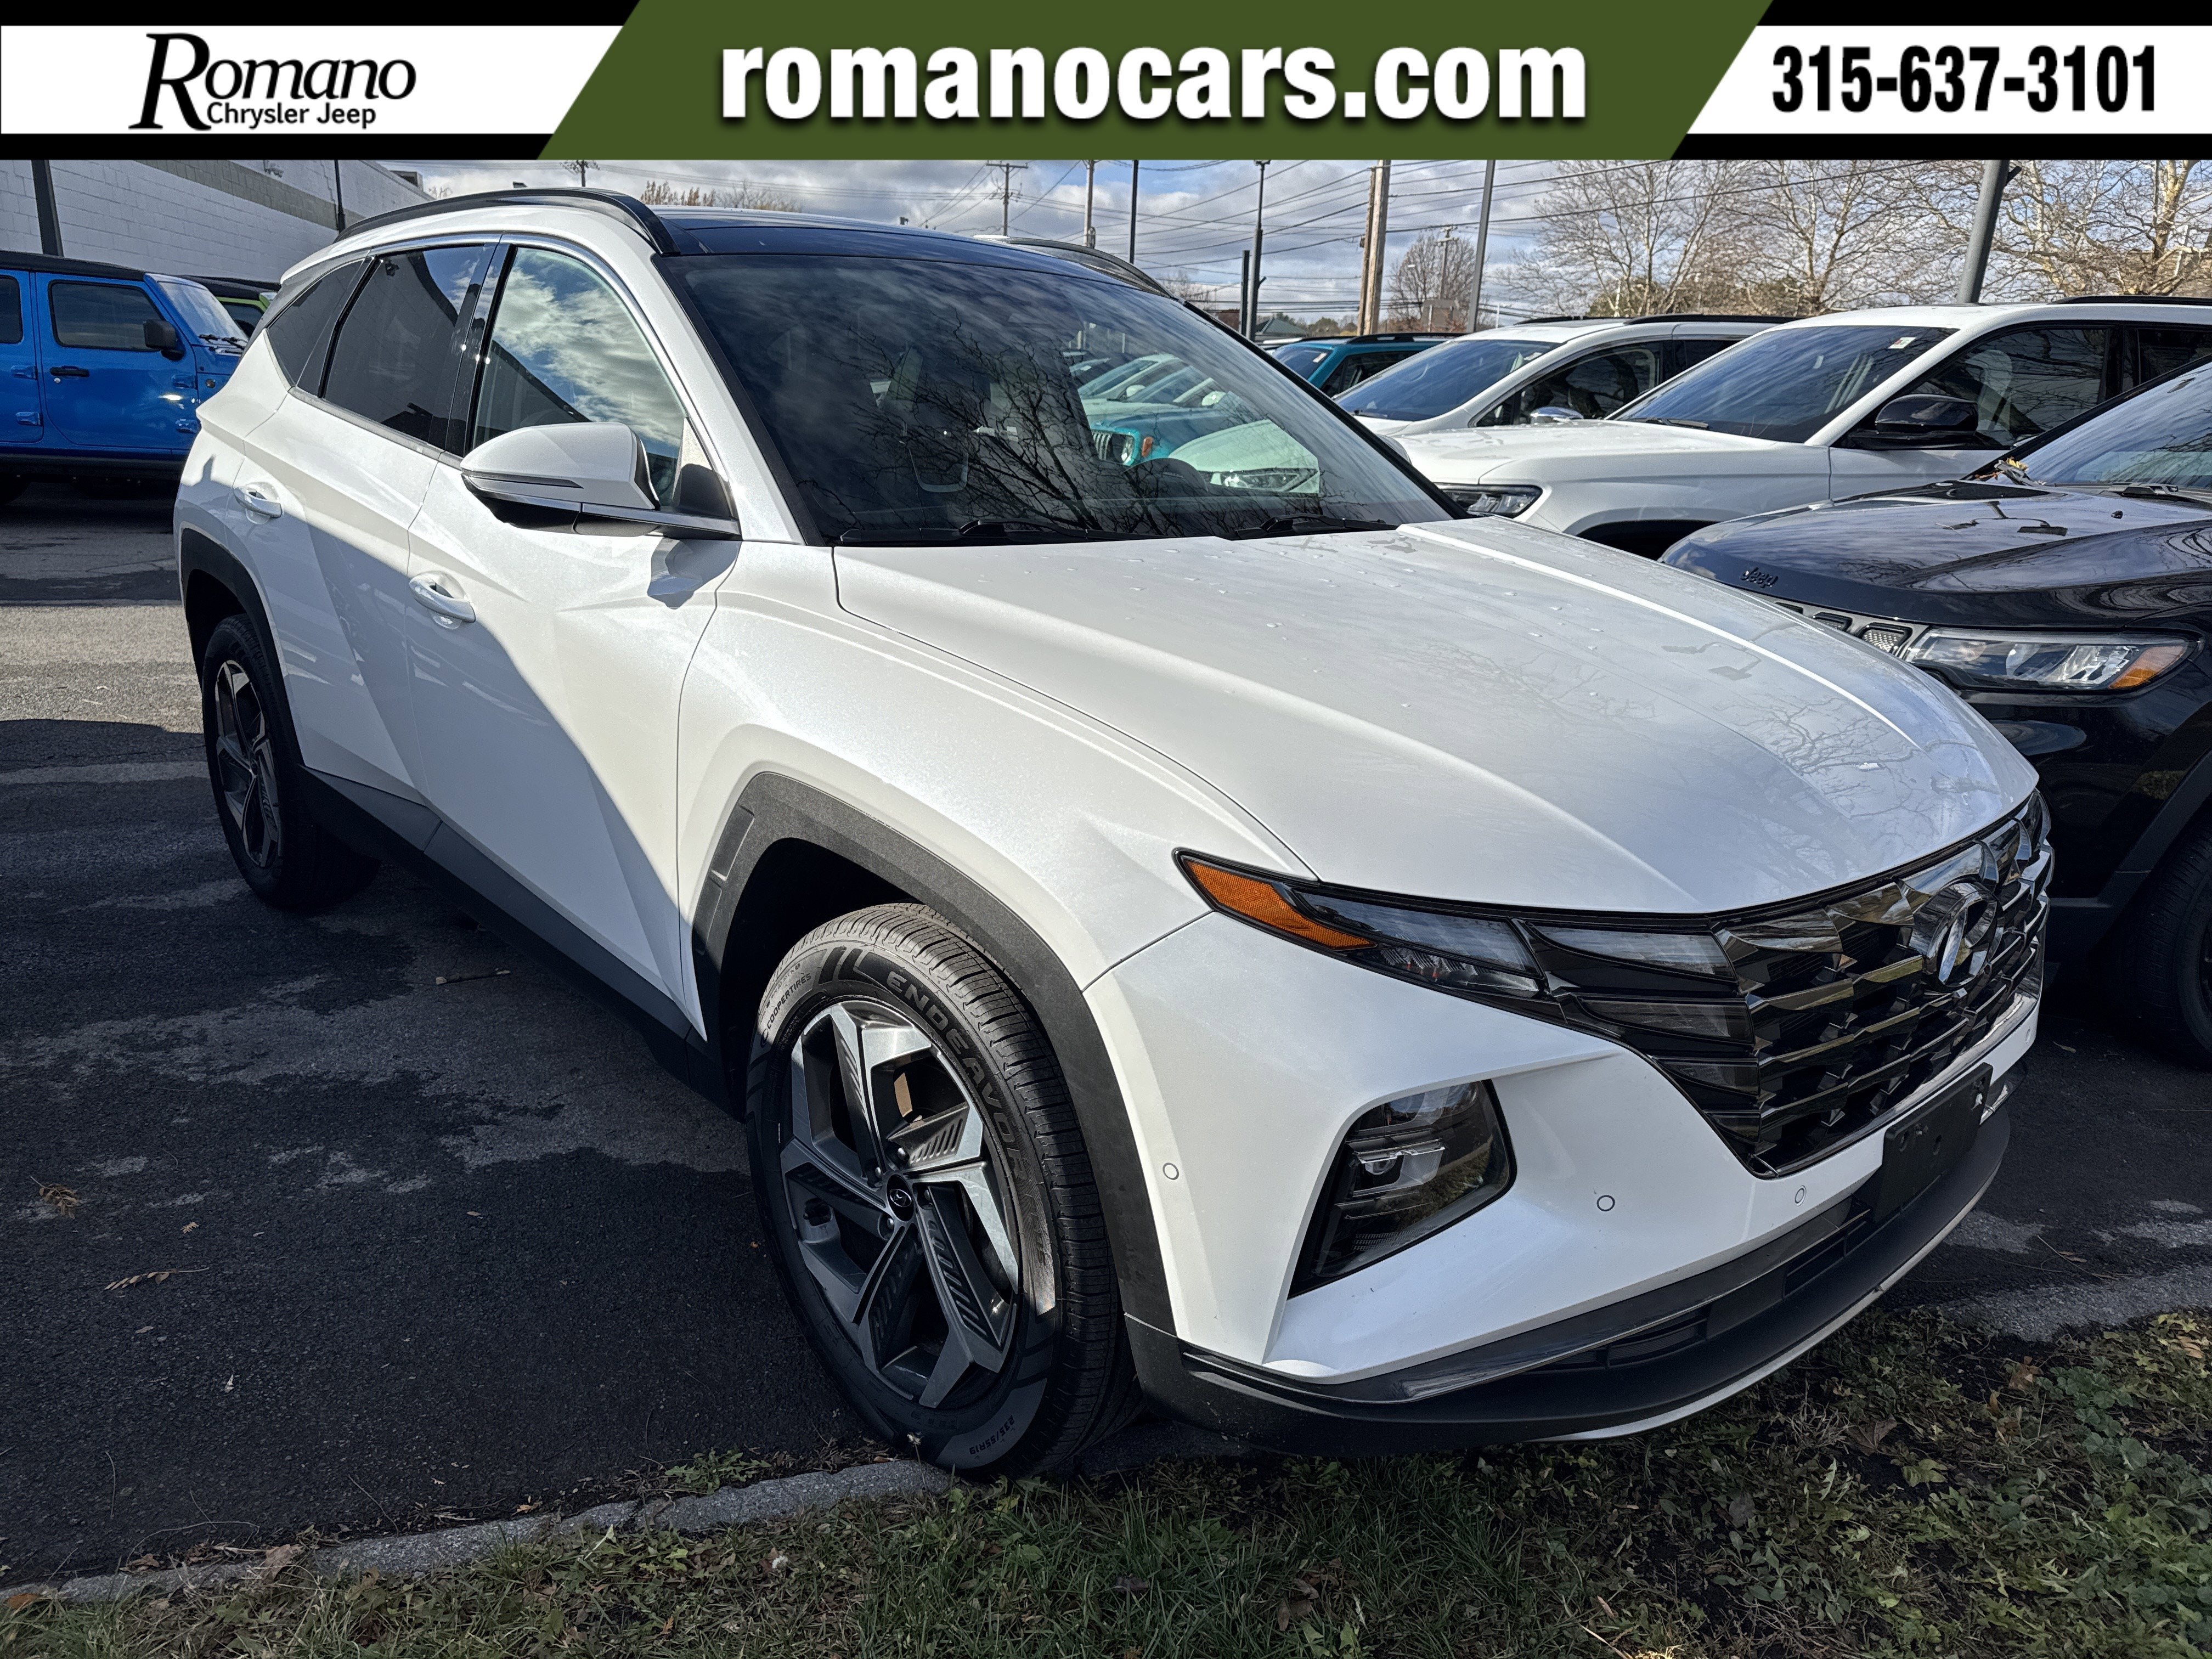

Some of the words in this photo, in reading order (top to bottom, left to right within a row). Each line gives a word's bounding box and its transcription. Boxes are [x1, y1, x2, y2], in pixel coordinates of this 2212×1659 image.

[1741, 567, 1778, 588] Jeep
[887, 970, 1029, 1182] ENDEAVOR
[969, 1415, 1015, 1455] 235/55R19
